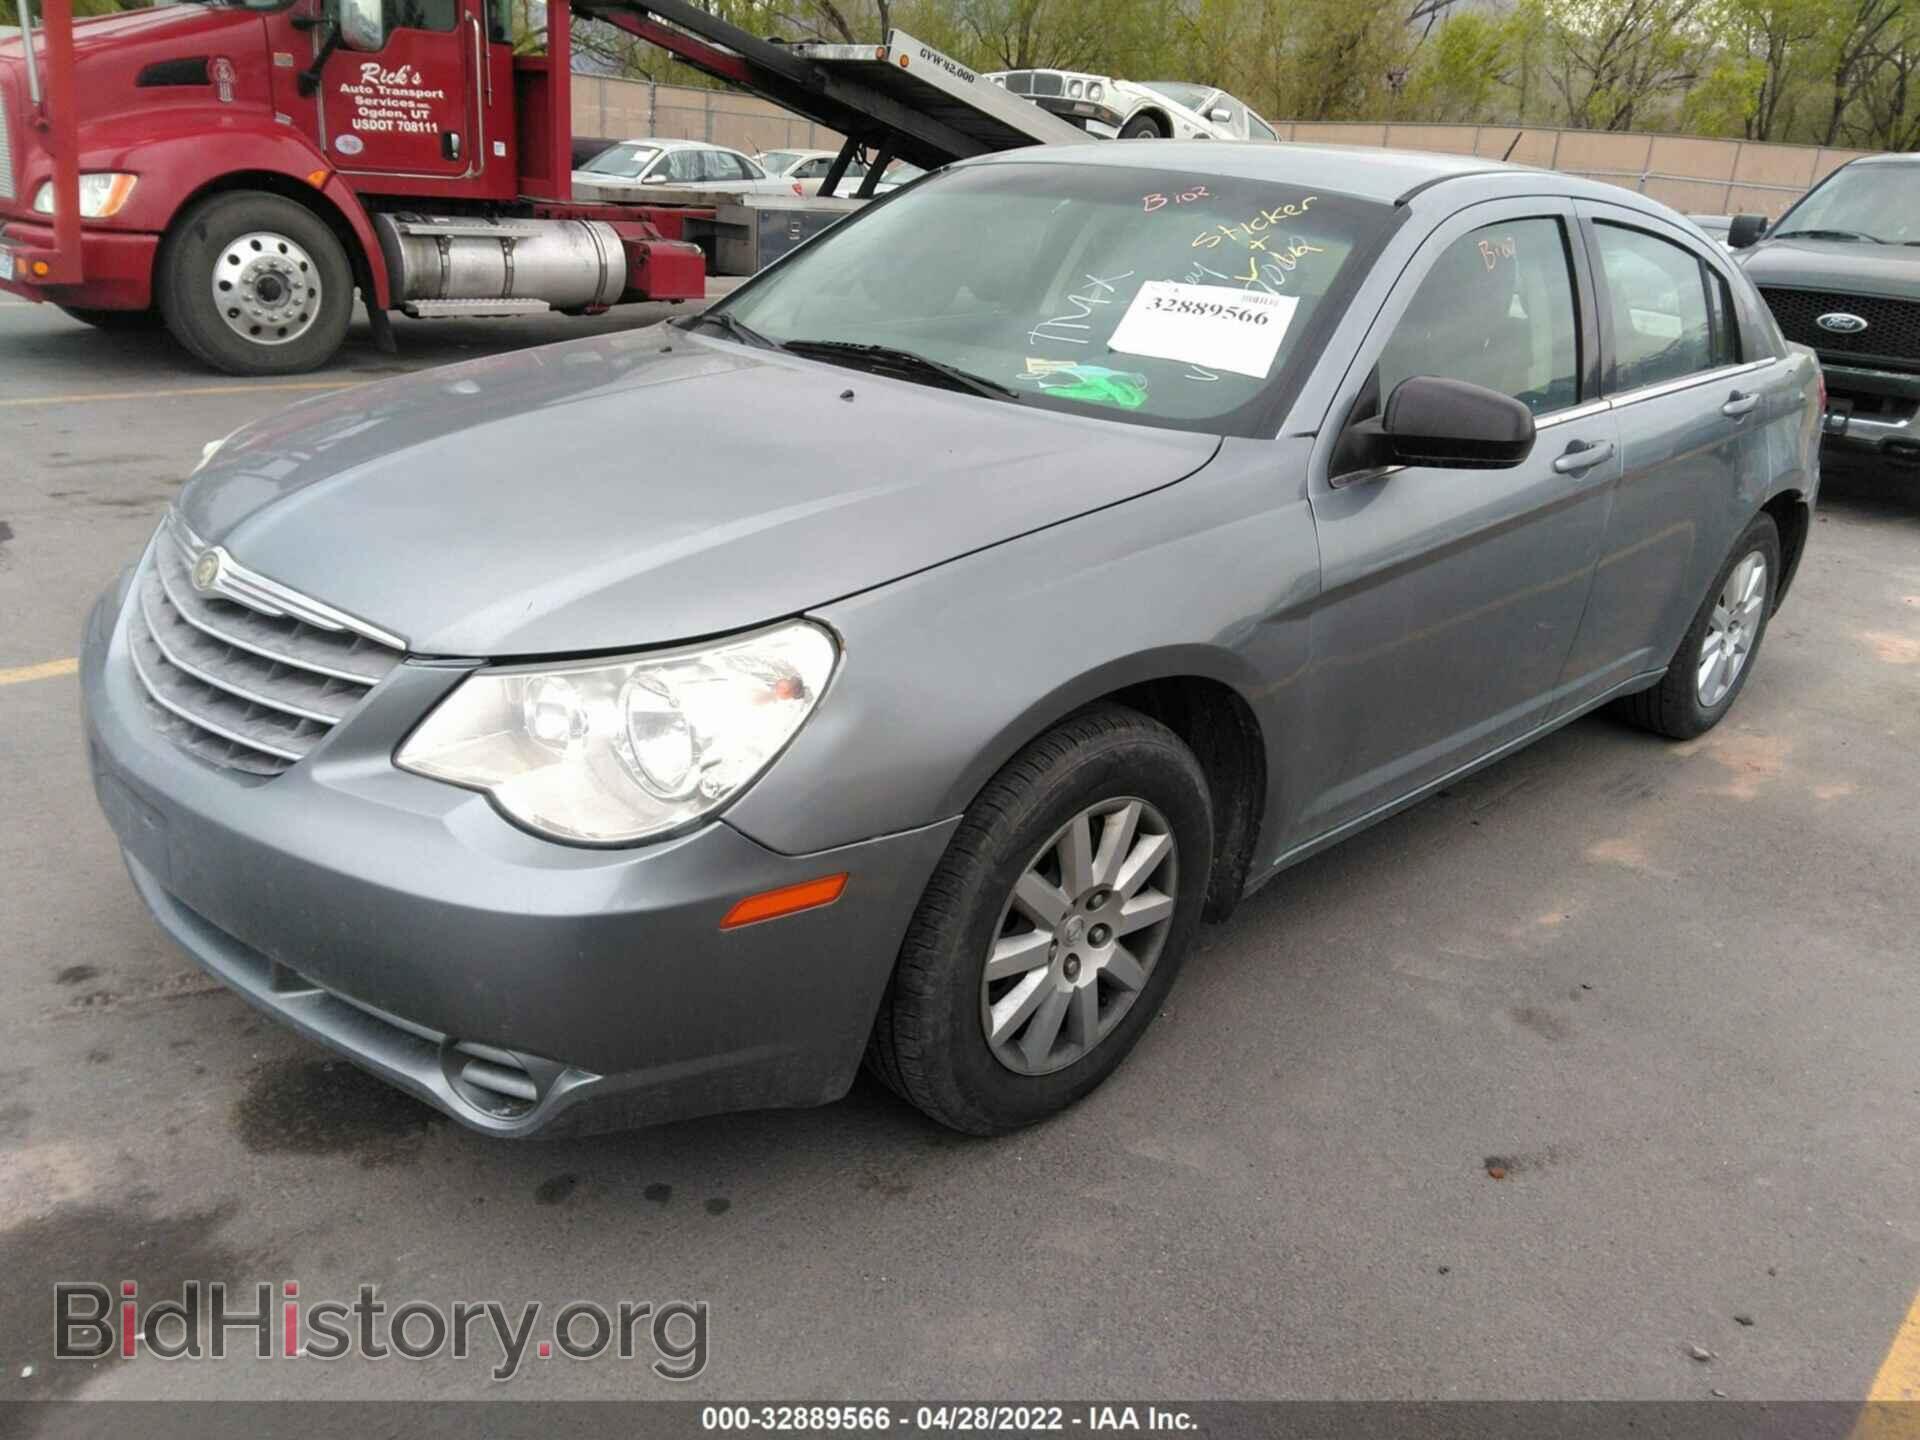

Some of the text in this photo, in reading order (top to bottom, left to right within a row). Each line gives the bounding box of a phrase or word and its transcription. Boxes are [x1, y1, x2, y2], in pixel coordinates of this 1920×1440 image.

[920, 47, 943, 65] GVW
[360, 62, 422, 85] Rick's
[340, 82, 444, 99] Auto Transport
[354, 95, 416, 108] Services
[358, 106, 430, 119] Ogden, UT
[352, 118, 438, 133] USDOT 708111
[1191, 195, 1318, 248] Sticker
[1146, 297, 1269, 327] 32889566
